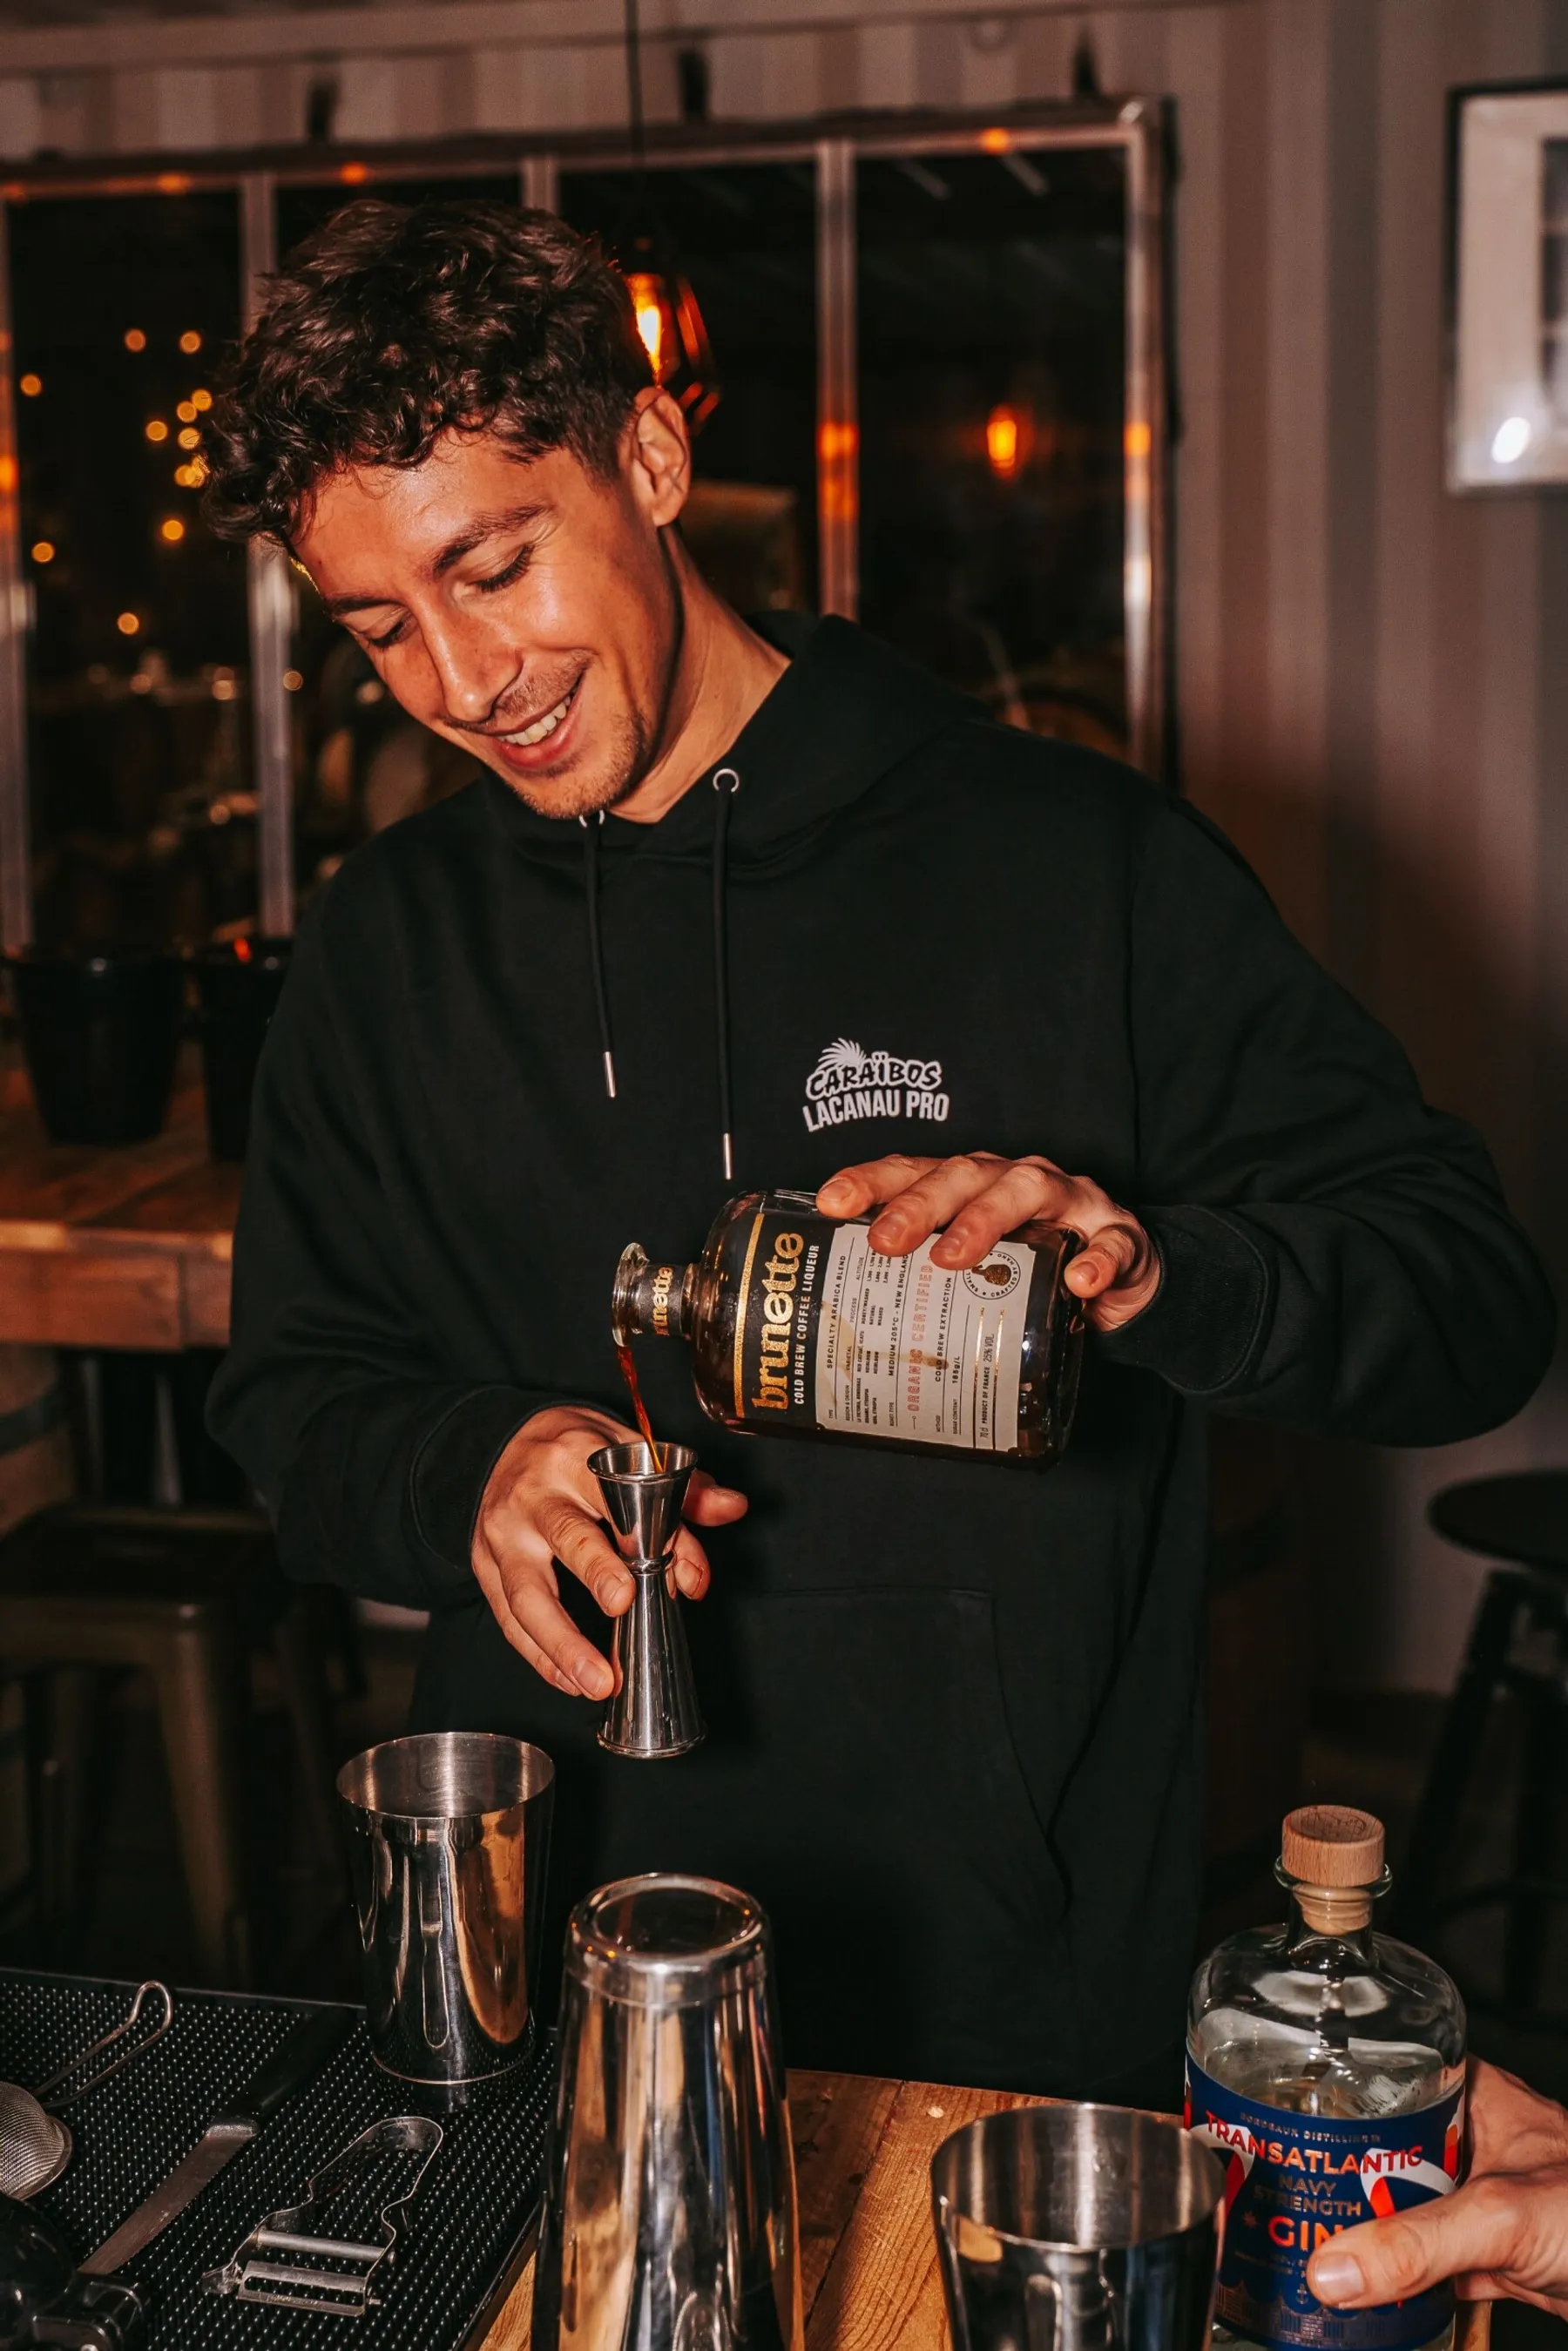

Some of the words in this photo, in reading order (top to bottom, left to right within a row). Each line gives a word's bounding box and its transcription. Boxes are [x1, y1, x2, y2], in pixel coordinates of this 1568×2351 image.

[807, 1051, 942, 1100] CARAÏBOS
[802, 1090, 901, 1132] LACANAU
[906, 1091, 950, 1121] PRO
[802, 1245, 820, 1292] LIQUEUR
[898, 1254, 908, 1288] ENGLAND
[966, 1273, 978, 1292] SMALL
[991, 1277, 1017, 1297] CRAFTED
[652, 1267, 673, 1336] runette
[751, 1233, 805, 1409] brunette
[797, 1295, 810, 1339] COFFEE
[827, 1324, 835, 1368] SPECIALTY
[831, 1283, 841, 1320] ARABICA
[836, 1255, 846, 1280] BLEND
[911, 1265, 933, 1341] CERTIFIED
[940, 1278, 951, 1329] EXTRACTION
[794, 1344, 805, 1375] BREW
[983, 1348, 992, 1362] 25%
[794, 1379, 804, 1404] COLD
[907, 1348, 923, 1411] ORGANIC
[1206, 2110, 1423, 2175] TRANSATLANTIC
[1254, 2185, 1362, 2217] STRENGTH
[1279, 2174, 1336, 2198] NAVY
